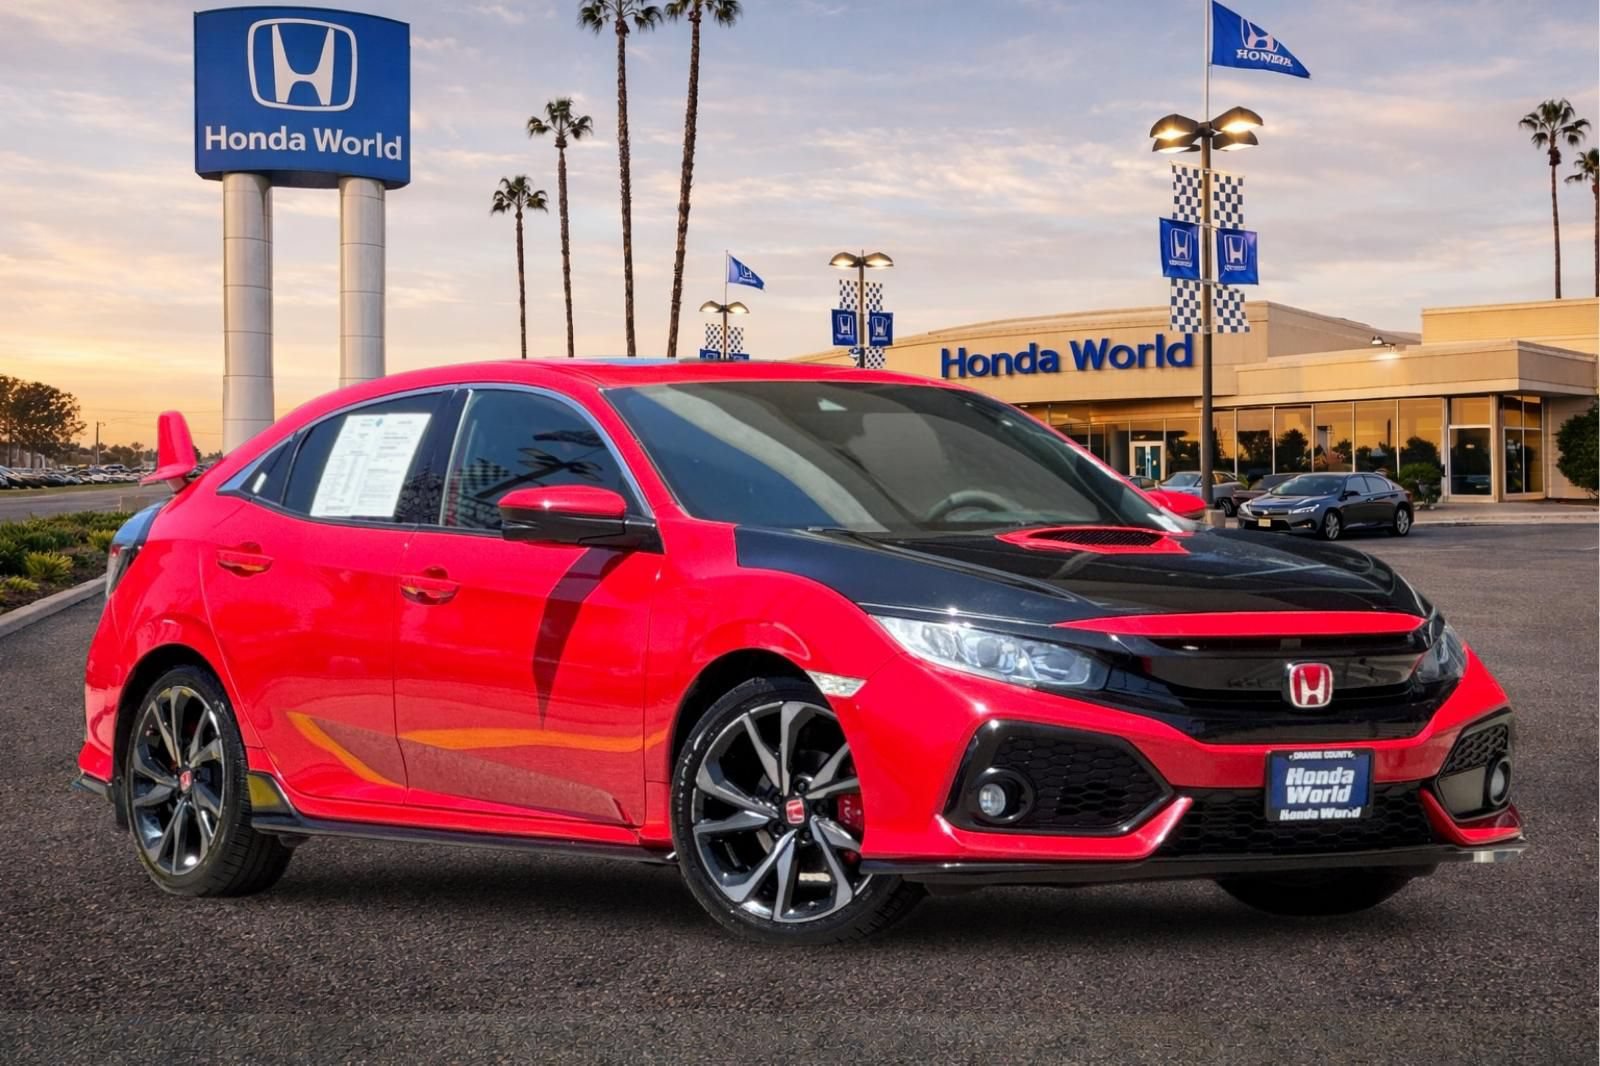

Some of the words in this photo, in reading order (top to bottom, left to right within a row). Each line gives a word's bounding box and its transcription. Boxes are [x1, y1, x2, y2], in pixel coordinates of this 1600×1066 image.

[205, 125, 306, 151] Honda
[313, 127, 402, 161] World
[941, 342, 1061, 378] Honda
[1069, 333, 1193, 371] World
[1324, 750, 1353, 759] COUNTY
[1285, 766, 1355, 785] Honda
[1287, 785, 1352, 804] World
[1279, 808, 1319, 820] Honda
